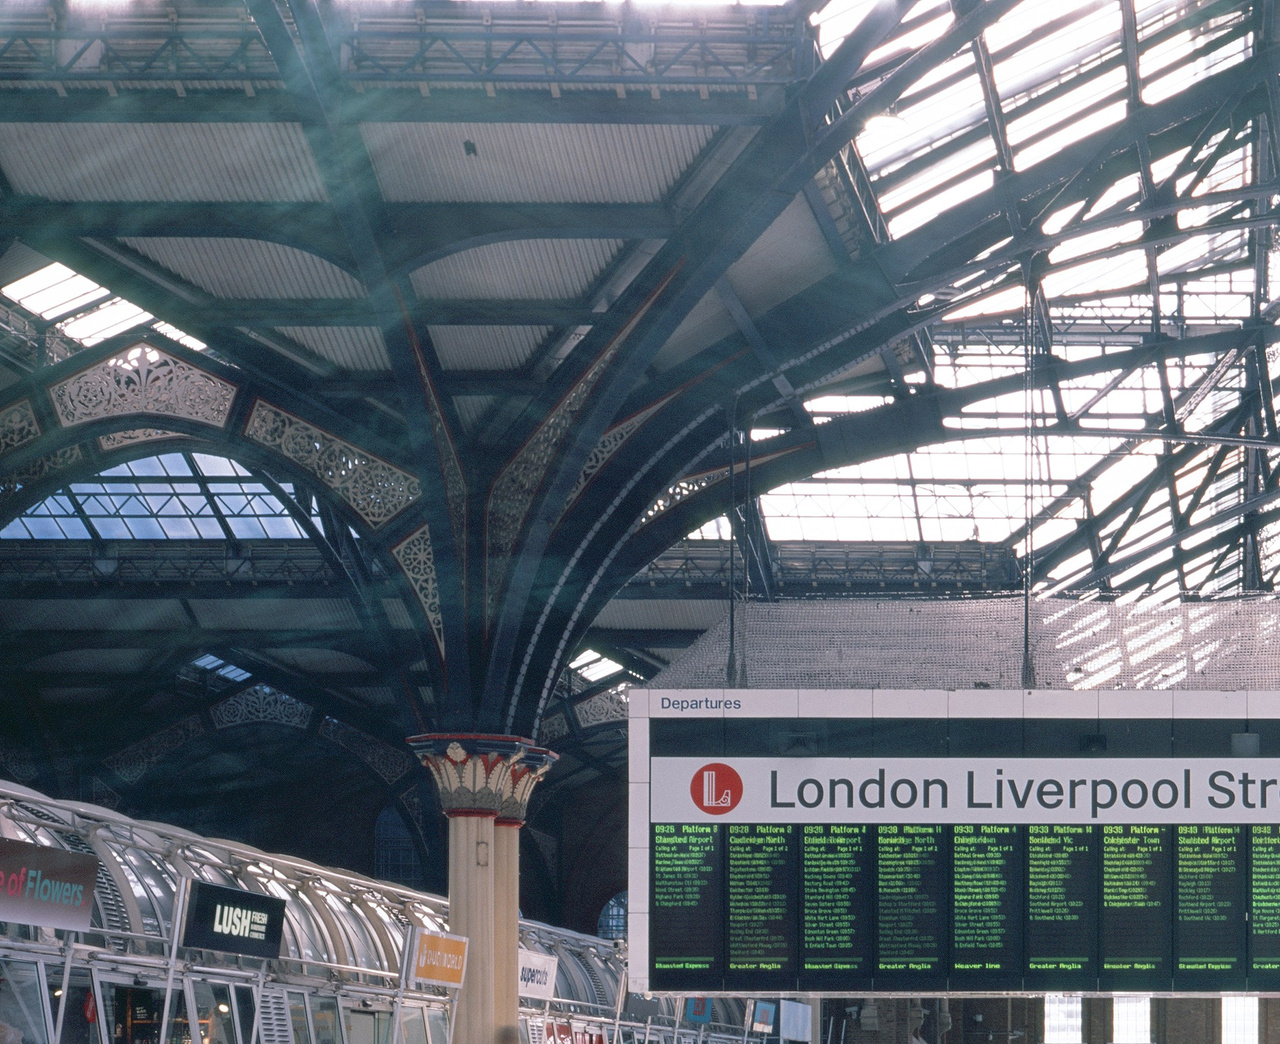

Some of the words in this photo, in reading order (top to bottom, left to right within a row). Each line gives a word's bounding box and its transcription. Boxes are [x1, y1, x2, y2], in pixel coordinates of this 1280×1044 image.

[661, 697, 742, 711] Departures
[770, 768, 948, 809] London
[967, 768, 1191, 819] Liverpool
[8, 867, 27, 897] of
[214, 904, 252, 937] LUSH
[252, 911, 268, 924] FRESH
[520, 966, 548, 988] supercuts
